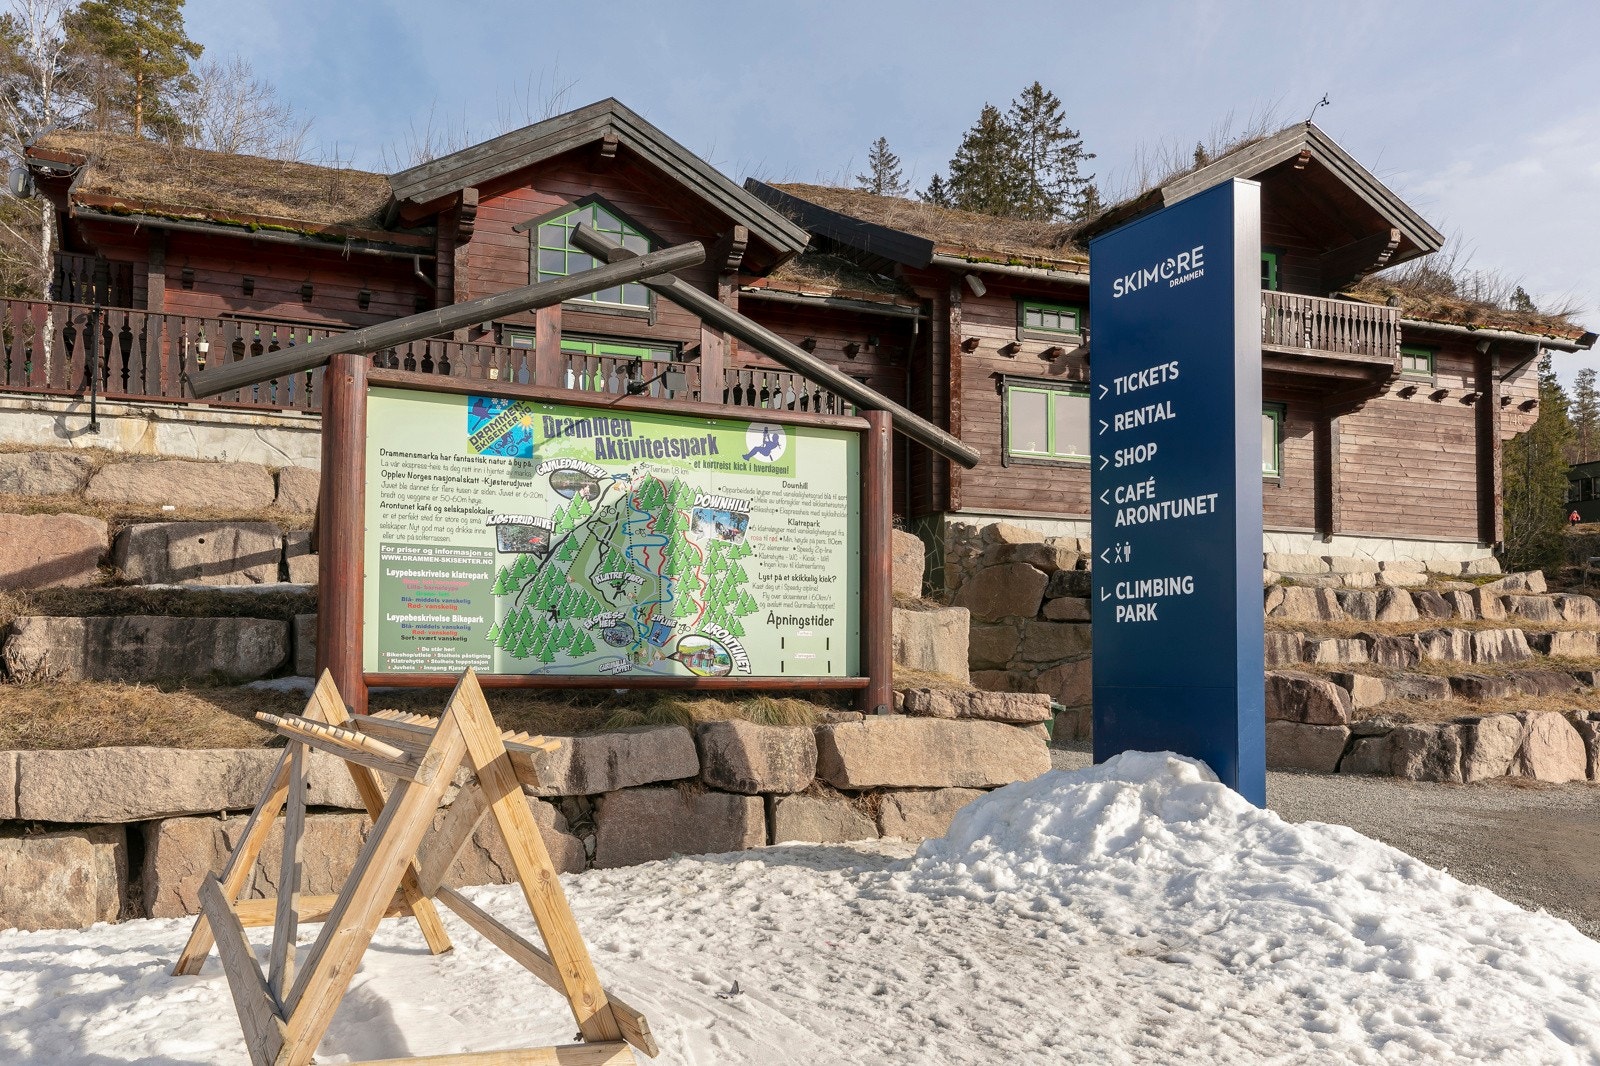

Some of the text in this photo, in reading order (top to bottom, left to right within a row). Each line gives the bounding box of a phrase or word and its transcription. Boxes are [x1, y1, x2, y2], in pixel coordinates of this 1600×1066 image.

[1113, 245, 1204, 298] SKIMORE
[1169, 268, 1204, 288] DRAMMEN
[1114, 361, 1179, 396] TICKETS
[469, 400, 525, 446] DRAMMEN-
[1114, 400, 1176, 432] RENTAL
[475, 406, 532, 452] SKISENTER.NO
[542, 416, 632, 438] Drammen
[596, 434, 719, 460] Aktivitetspark
[1114, 442, 1158, 468] SHOP
[380, 448, 438, 460] Drammensmarka
[440, 453, 451, 461] har
[454, 454, 486, 464] fantastisk
[514, 459, 521, 467] by
[703, 460, 732, 470] kortreist
[734, 461, 746, 470] kick
[754, 464, 789, 474] hverdagen!
[381, 470, 405, 480] Opplev
[407, 472, 432, 482] Norges
[434, 475, 479, 484] nasjonalskatt
[536, 458, 608, 478] GAMLEDAMMEN
[782, 481, 808, 489] Downhill
[1114, 476, 1156, 504] CAFÉ
[380, 501, 415, 510] Arontunet
[417, 503, 432, 511] kafé
[444, 505, 494, 515] selskapslokaler
[694, 494, 750, 513] DOWNHILL
[1114, 493, 1218, 528] ARONTUNET
[486, 514, 556, 533] KJØSTERUDJUVET
[788, 518, 820, 528] Klatrepark
[381, 555, 493, 564] WWW.DRAMMEN-SKISENTER.NO
[435, 548, 481, 557] informasjon
[386, 568, 488, 580] Løypebeskrivelse klatrepark
[595, 572, 645, 585] KLATRE PARK
[758, 573, 772, 582] Lyst
[774, 574, 782, 582] på
[792, 574, 817, 584] skikkelig
[1116, 575, 1194, 600] CLIMBING
[386, 613, 484, 624] Løypebeskrivelse Bikepark
[584, 612, 626, 630] EKSPRESS HEIS
[766, 610, 834, 629] Åpningstider
[1116, 602, 1158, 623] PARK
[702, 623, 751, 674] ARONTUNET
